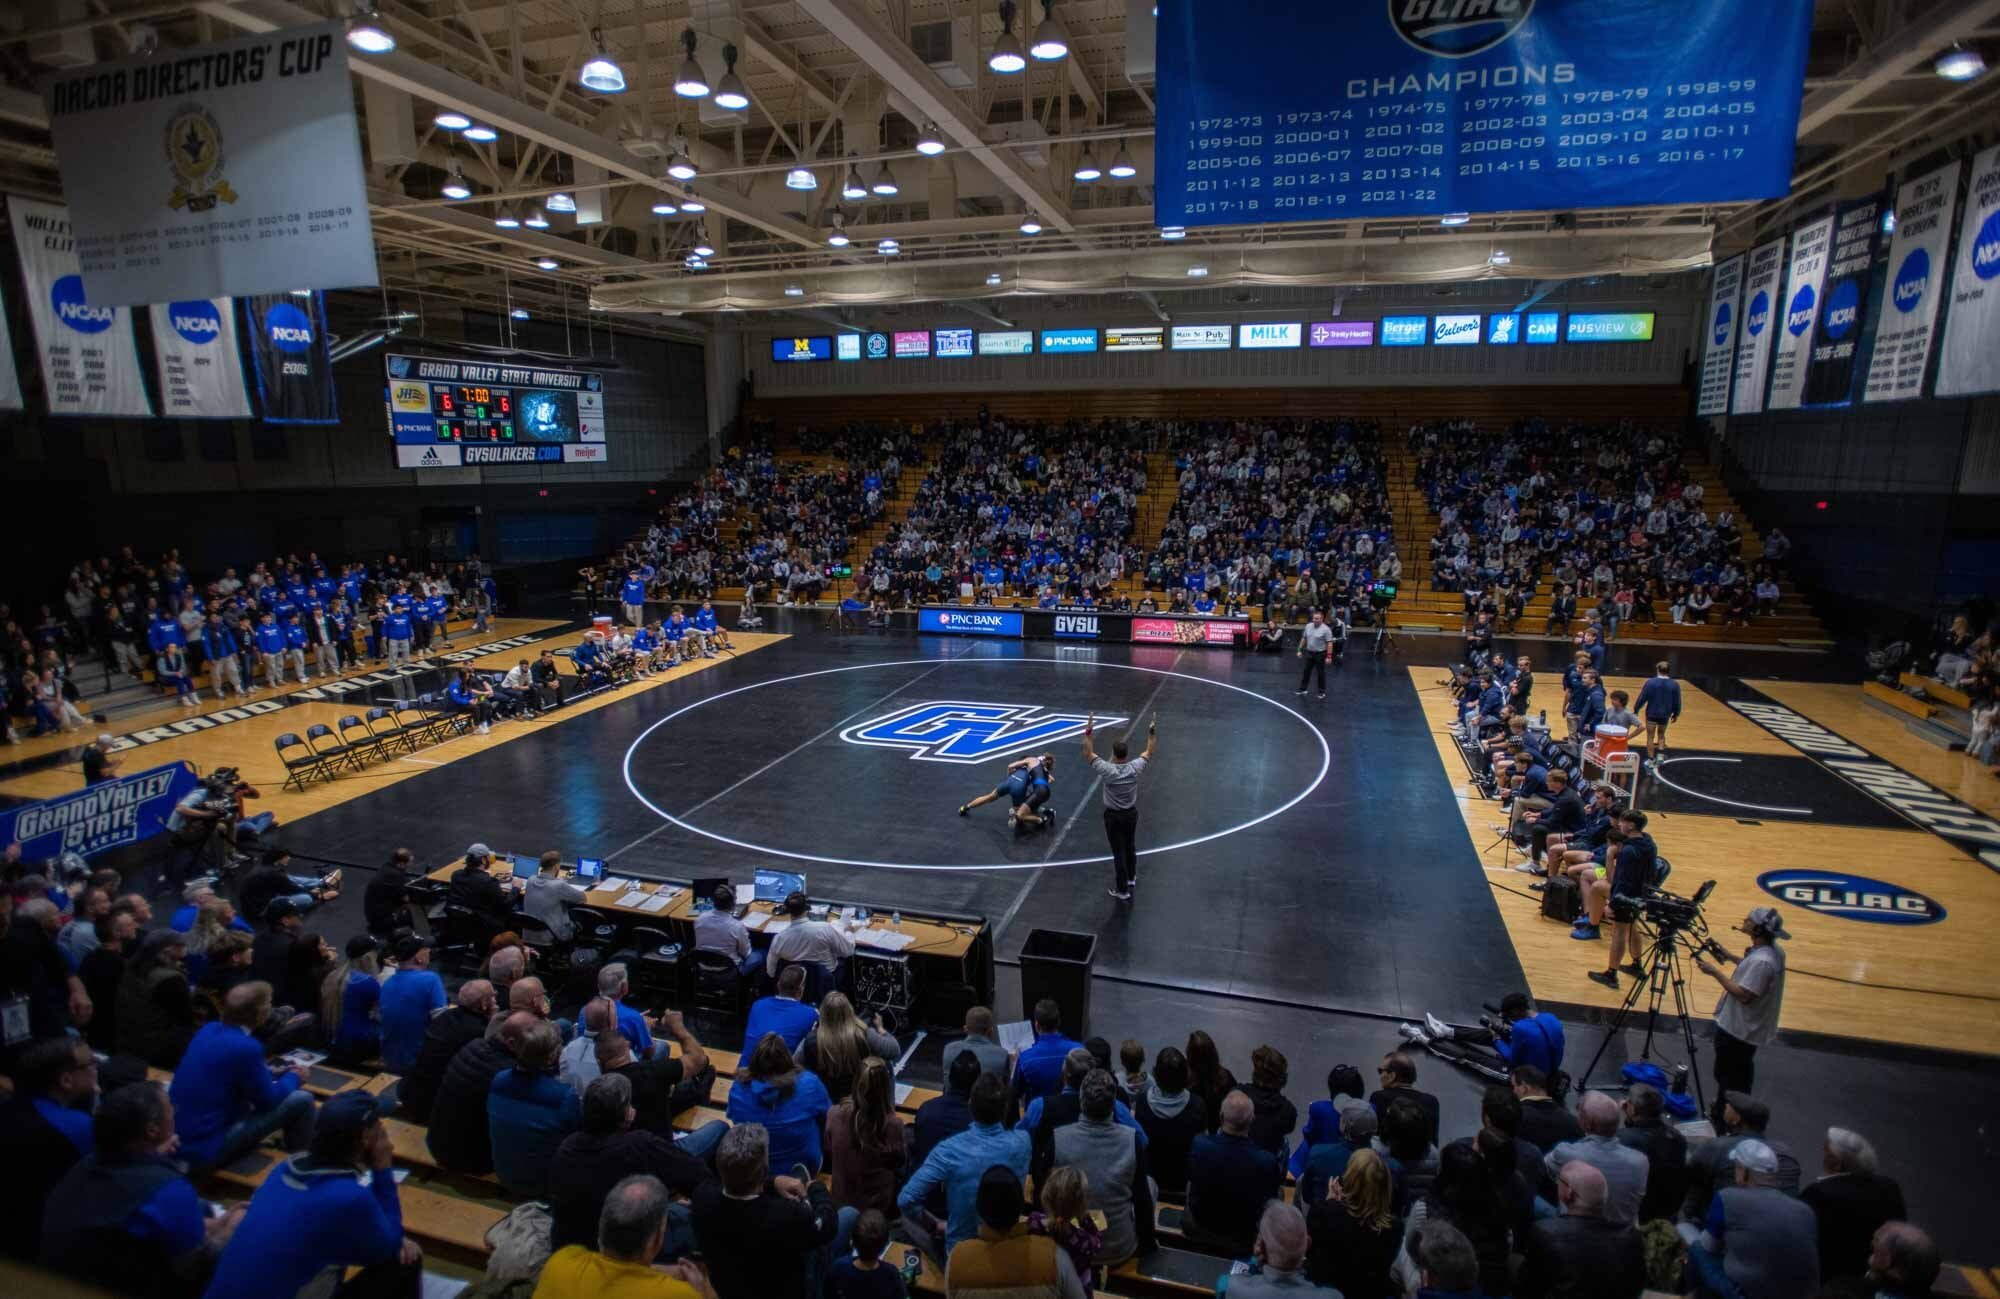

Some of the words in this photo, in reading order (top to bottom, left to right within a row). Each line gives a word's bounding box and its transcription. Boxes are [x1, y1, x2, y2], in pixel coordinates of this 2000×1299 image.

[134, 45, 273, 102] DIRECTORS'
[279, 34, 332, 77] CUP
[1346, 63, 1576, 99] CHAMPIONS
[1189, 116, 1262, 131] 1972-73
[1276, 109, 1352, 125] 1973-74
[1368, 102, 1446, 118] 1974-75
[1464, 95, 1546, 112] 1977-78
[1562, 88, 1649, 105] 1978-79
[1665, 80, 1756, 97] 1998-99
[1189, 136, 1262, 150] 1999-00
[1274, 130, 1350, 145] 2000-01
[1365, 123, 1445, 138] 2001-02
[1461, 115, 1547, 133] 2002-03
[1560, 110, 1649, 126] 2003-04
[1663, 102, 1756, 119] 2004-05
[1187, 155, 1262, 170] 2005-06
[1273, 150, 1352, 165] 2006-07
[1364, 144, 1443, 158] 2007-08
[1461, 136, 1546, 153] 2008-09
[1559, 130, 1647, 146] 2009-10
[1661, 125, 1750, 141] 2010-11
[1186, 177, 1261, 192] 2011-12
[1273, 172, 1351, 187] 2012-13
[1362, 167, 1441, 181] 2013-14
[1459, 160, 1541, 176] 2014-15
[1556, 154, 1641, 169] 2015-16
[1657, 149, 1745, 163] 2016-17
[1185, 199, 1259, 214] 2017-18
[1274, 194, 1347, 209] 2018-19
[1361, 190, 1437, 203] 2021-22
[59, 302, 114, 323] NCAA
[1828, 305, 1856, 326] NCAA
[175, 316, 220, 333] NCAA
[273, 327, 311, 343] NCAA
[1206, 330, 1224, 339] Pub
[1251, 326, 1289, 340] MILK
[1436, 319, 1479, 340] Culver's
[1528, 324, 1557, 335] CAM
[1569, 323, 1625, 334] PUSVIEW
[794, 338, 810, 352] M
[419, 362, 458, 379] GRAND
[462, 365, 499, 382] VALLEY
[501, 370, 530, 385] STATE
[532, 372, 582, 389] UNIVERSITY
[442, 393, 453, 410] 6
[500, 396, 511, 412] 6
[462, 387, 490, 403] 7:00
[574, 446, 597, 460] meijer
[289, 661, 438, 698] VALLEY
[440, 635, 543, 662] STATE
[66, 803, 135, 848] STATE
[79, 829, 130, 853] AKERS
[1784, 887, 1926, 912] GLIAC
